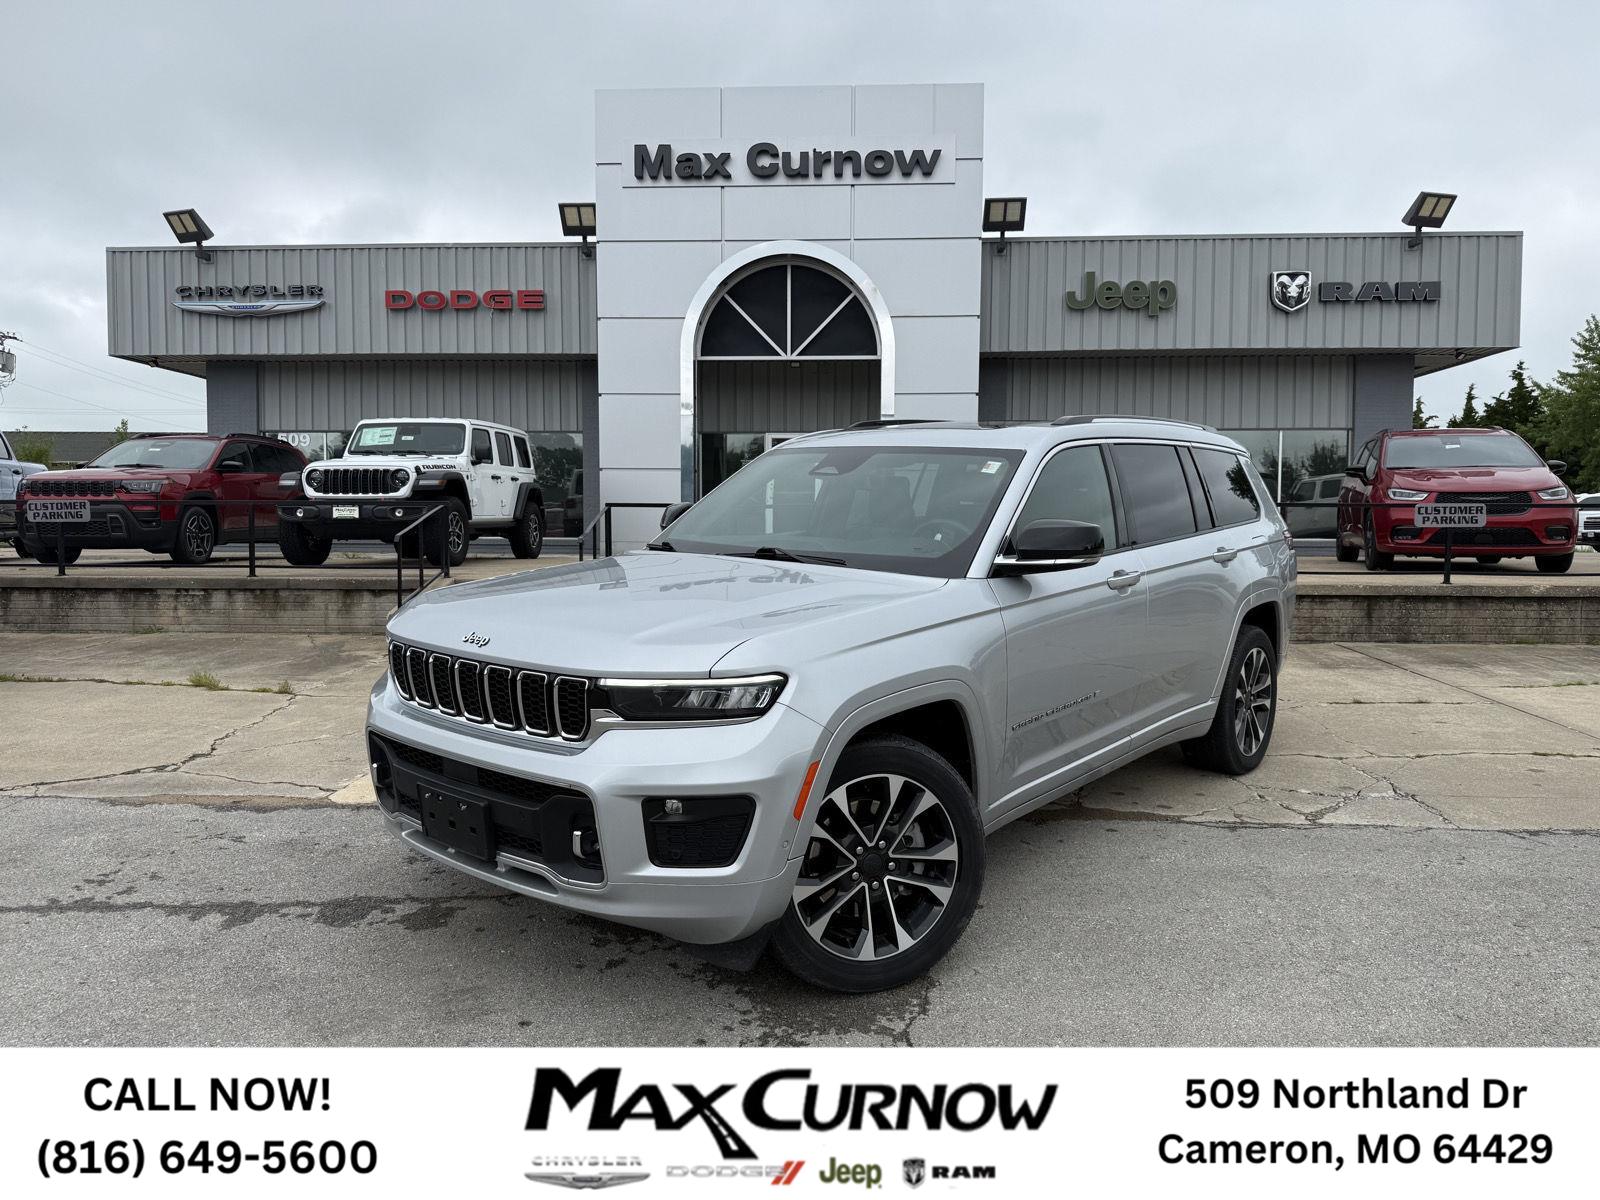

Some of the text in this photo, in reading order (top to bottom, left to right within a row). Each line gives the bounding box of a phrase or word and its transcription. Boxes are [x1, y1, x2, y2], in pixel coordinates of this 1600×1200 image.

[634, 142, 941, 180] Max Curnow
[175, 284, 324, 298] CHRYSLER
[1066, 271, 1177, 316] Jeep
[1319, 281, 1441, 303] RAM
[385, 289, 545, 310] DODGE
[277, 433, 310, 447] 509
[28, 502, 87, 511] CUSTOMER
[1417, 506, 1484, 515] CUSTOMER
[33, 511, 83, 520] PARKING
[1422, 516, 1479, 525] PARKING
[462, 631, 491, 648] Jeep
